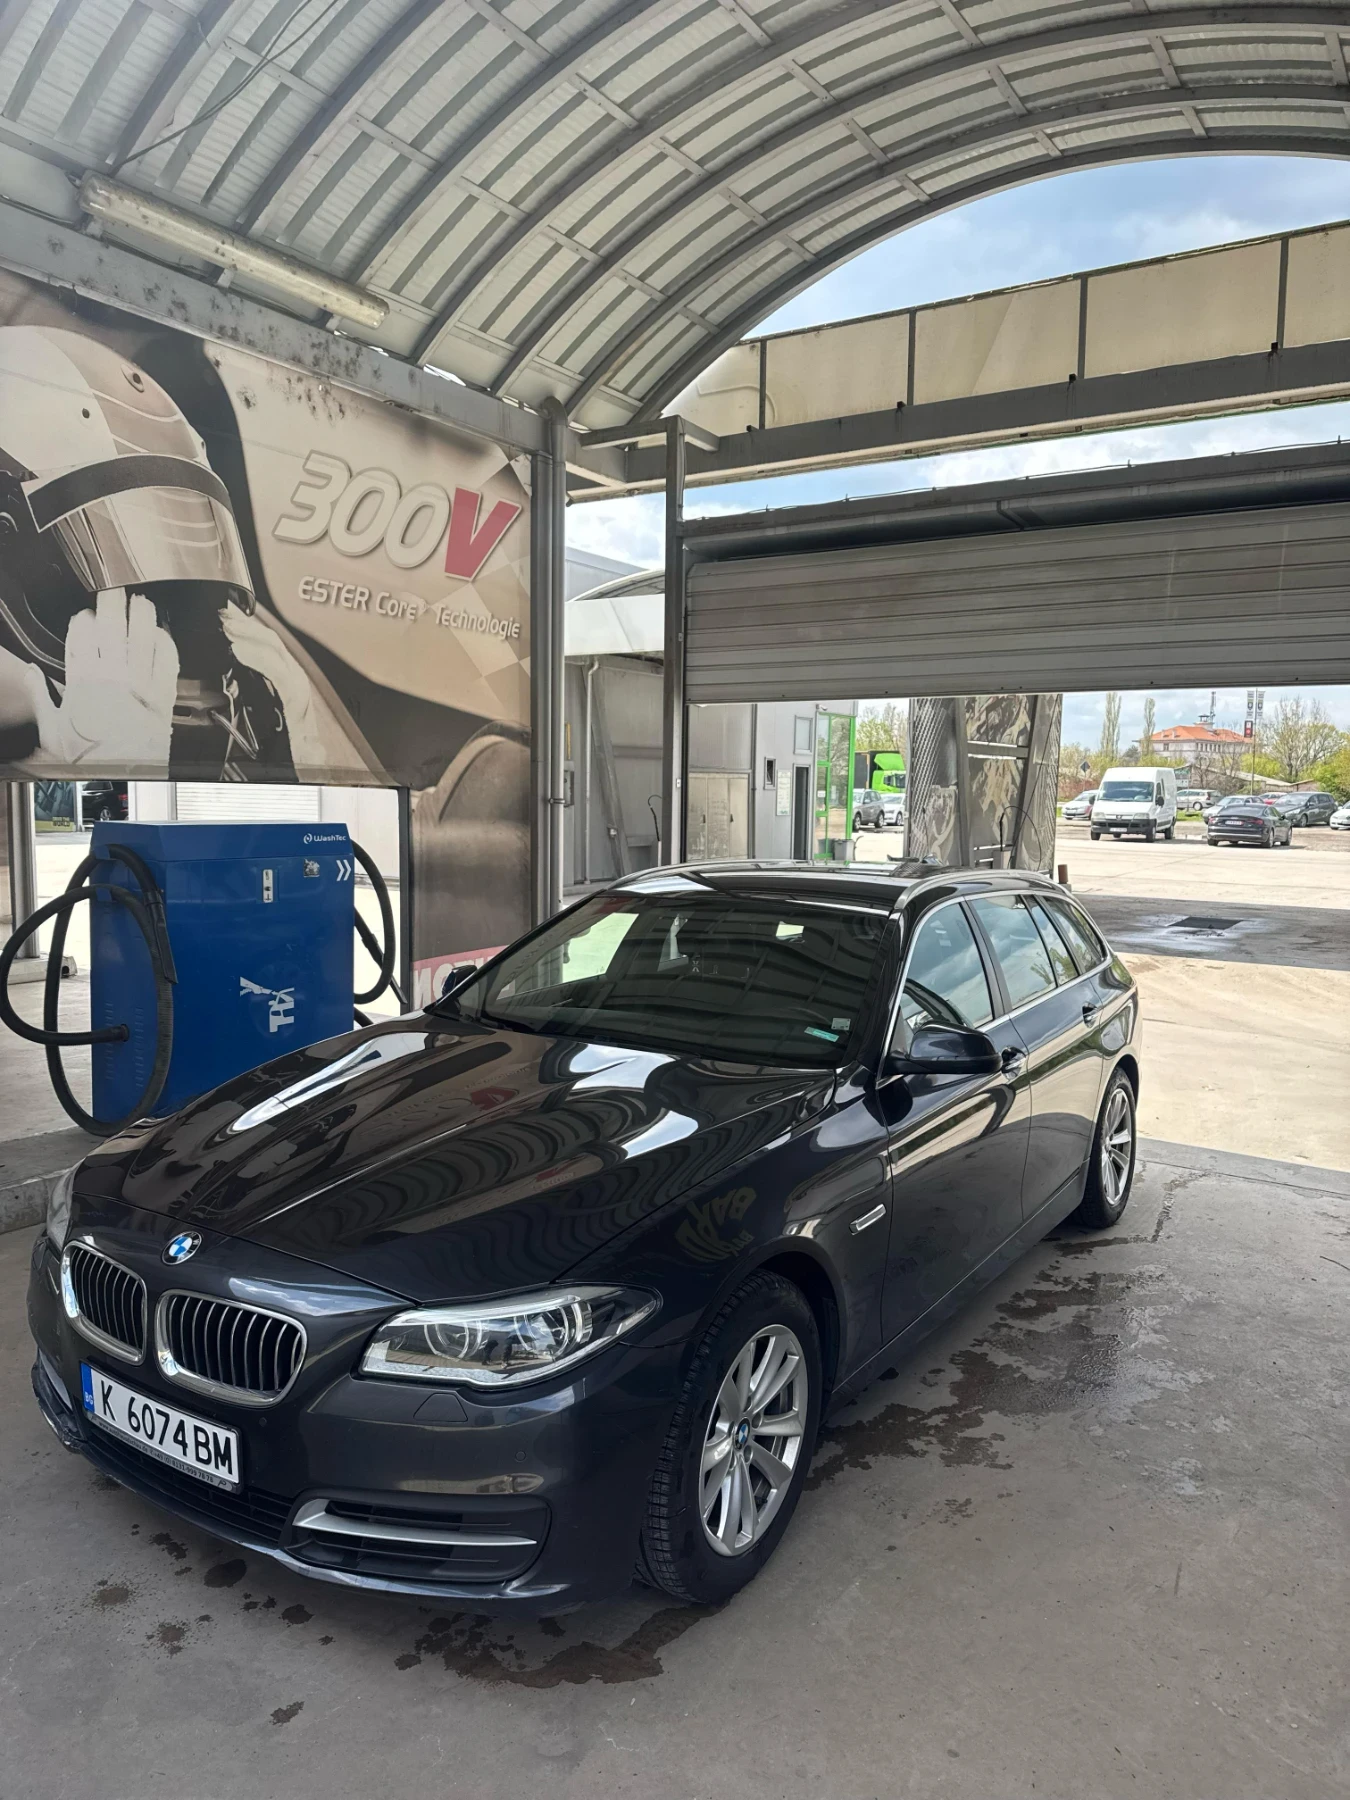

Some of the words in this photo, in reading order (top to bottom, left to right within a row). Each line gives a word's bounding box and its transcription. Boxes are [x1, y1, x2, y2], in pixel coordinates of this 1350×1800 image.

[271, 449, 522, 582] 300V
[298, 575, 370, 611] ESTER
[433, 603, 522, 640] Technologie
[313, 834, 347, 842] WashTec
[84, 1391, 94, 1406] BG
[100, 1379, 118, 1422] K
